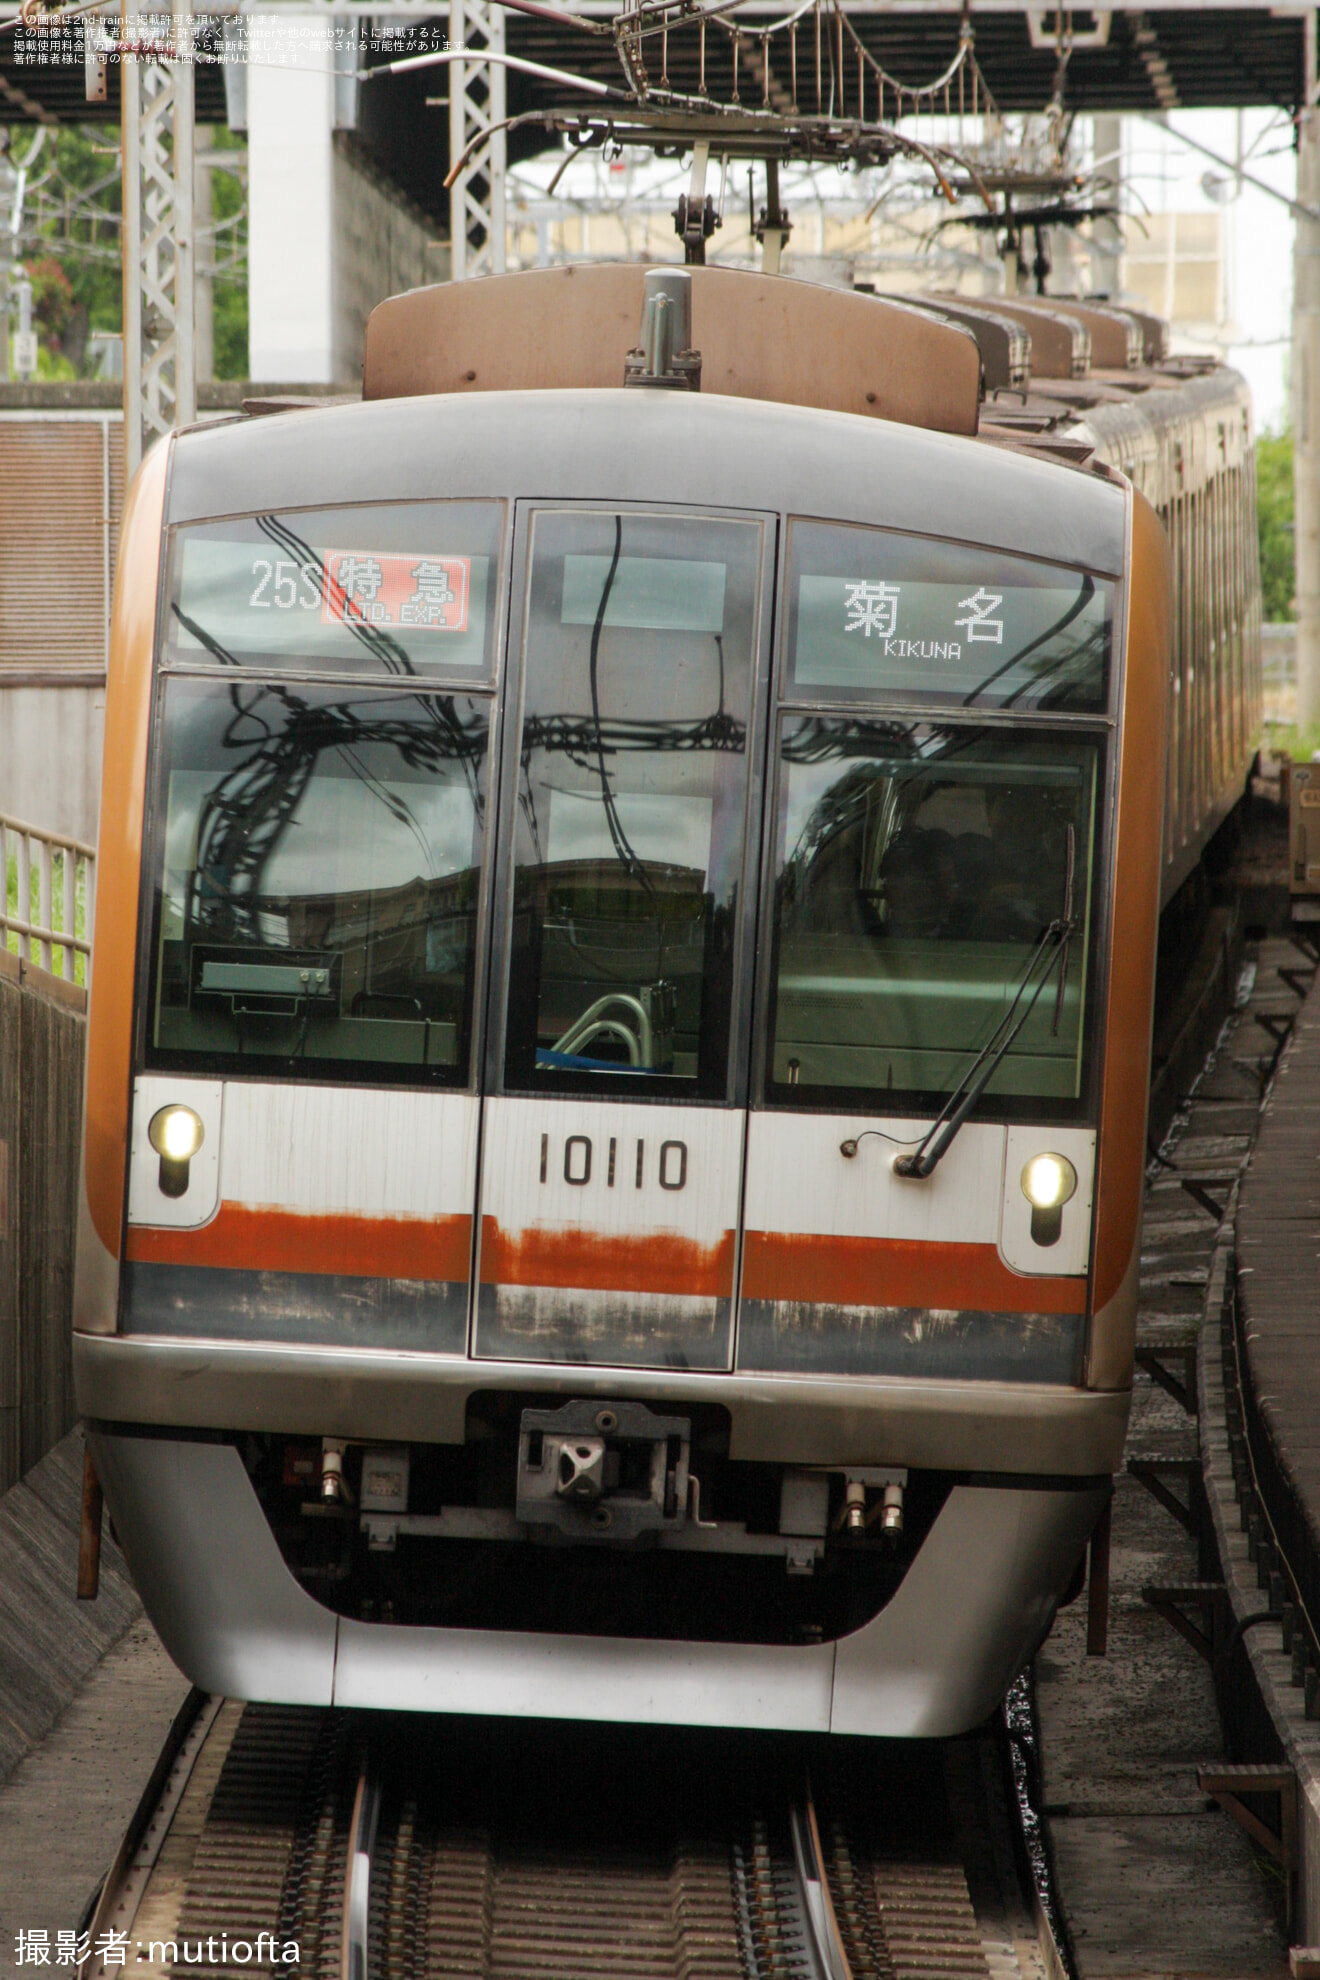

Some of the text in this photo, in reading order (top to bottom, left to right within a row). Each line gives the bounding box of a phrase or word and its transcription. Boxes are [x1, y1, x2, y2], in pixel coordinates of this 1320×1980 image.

[248, 559, 323, 610] 25S
[338, 557, 454, 603] 特急
[343, 601, 446, 624] LTD. EXP.
[844, 580, 1003, 644] 菊名
[884, 639, 961, 660] KIKUNA
[540, 1133, 688, 1191] 10110
